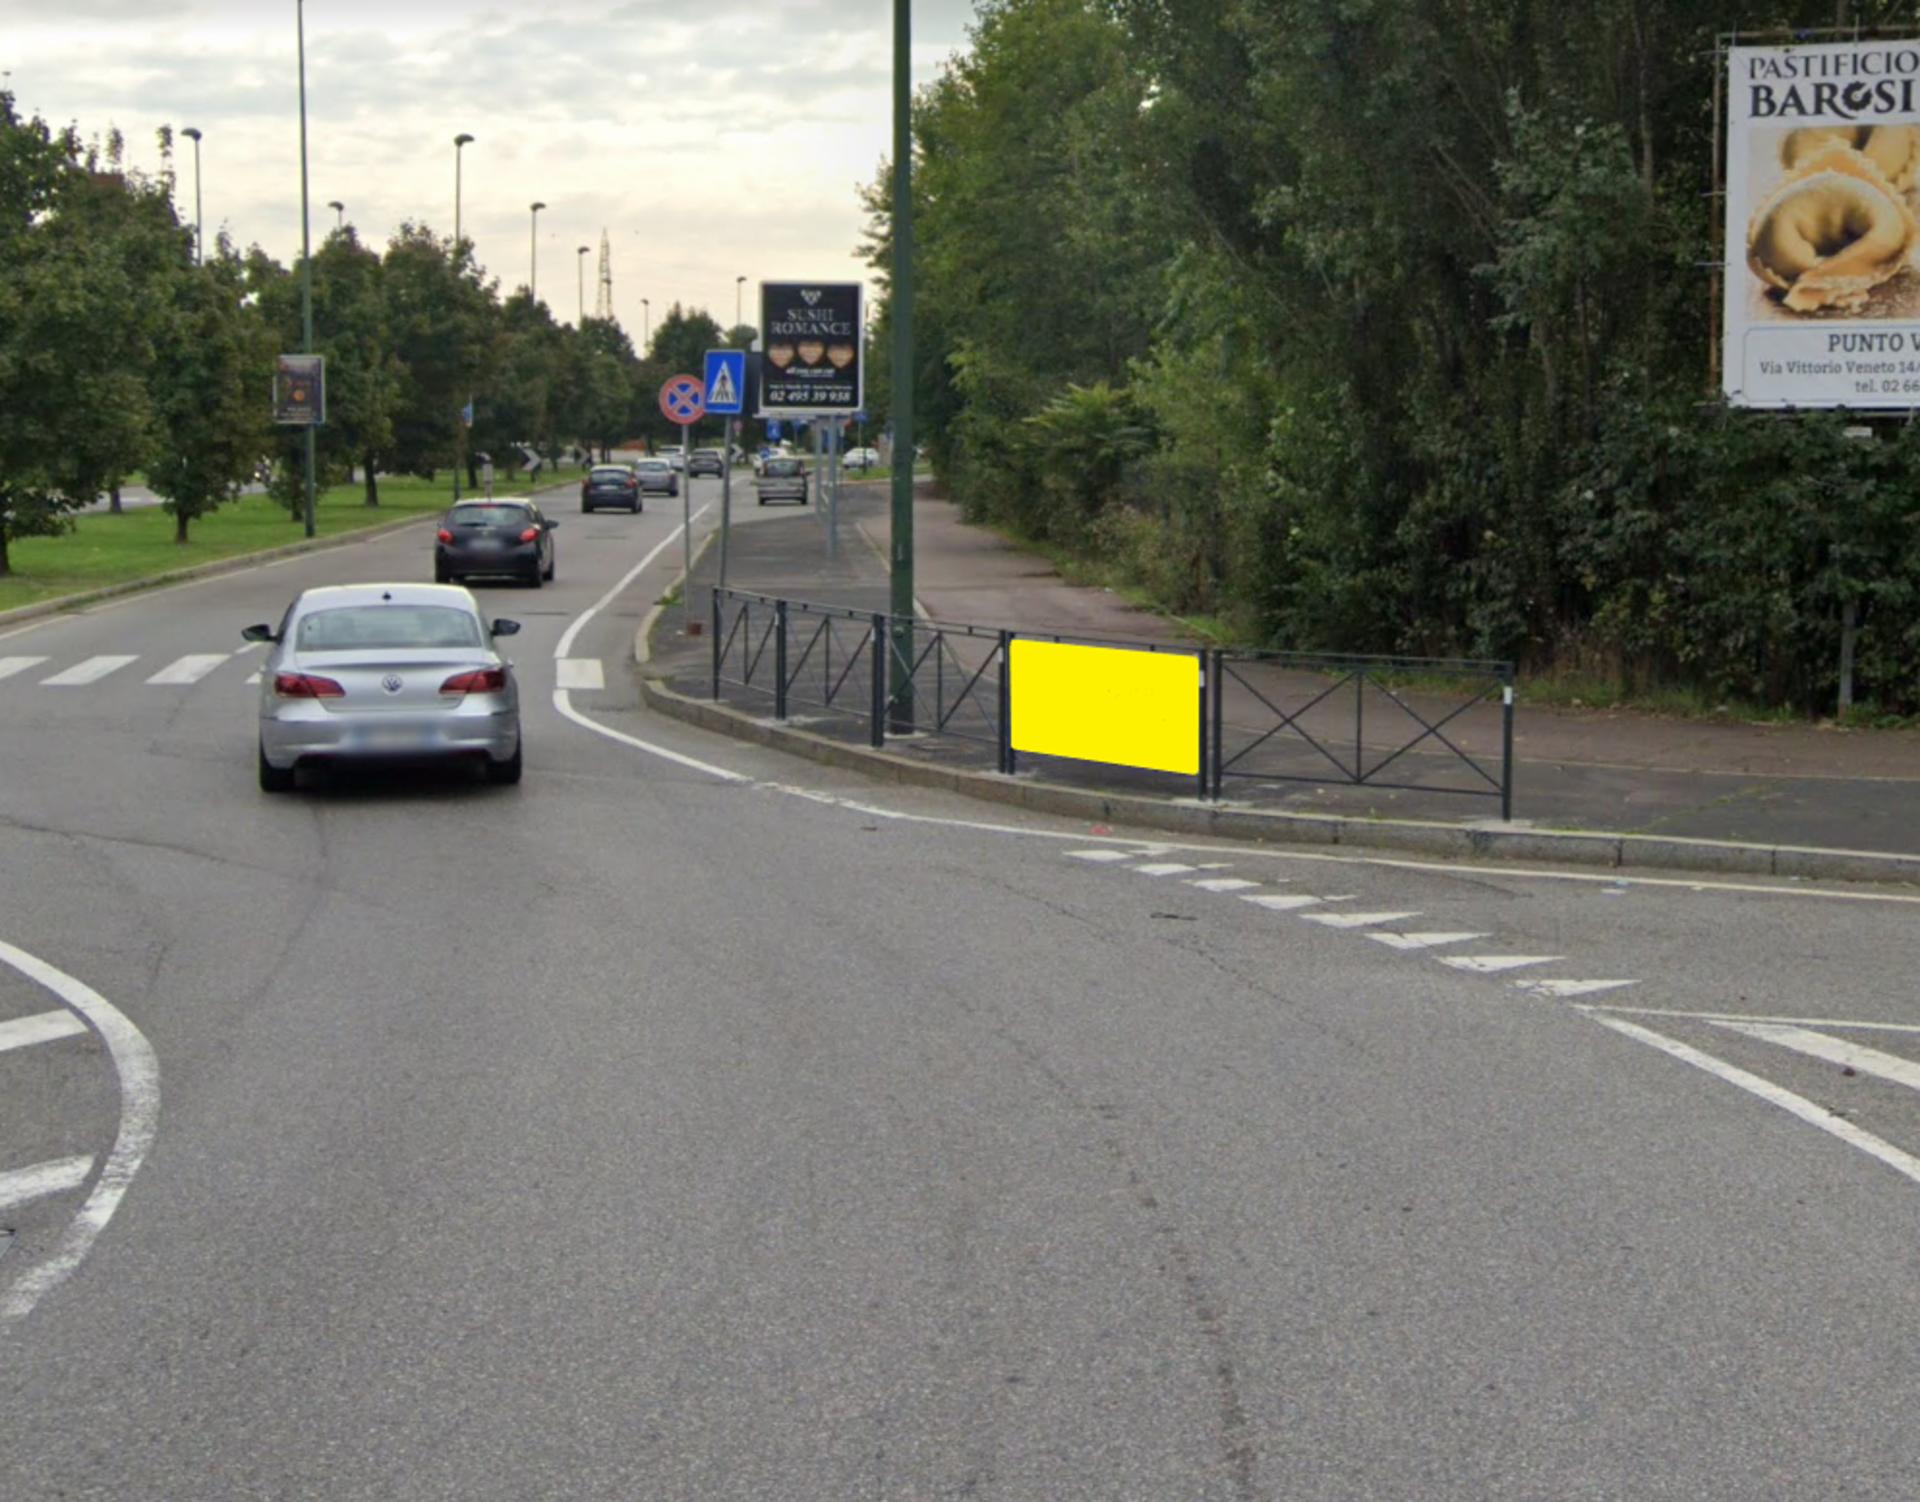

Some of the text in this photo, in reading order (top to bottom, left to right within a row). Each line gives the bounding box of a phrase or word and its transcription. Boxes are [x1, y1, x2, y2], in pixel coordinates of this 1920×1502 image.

[1750, 50, 1919, 79] PASTIFICIO
[1749, 79, 1916, 119] BAROSI
[787, 308, 834, 321] SUSHI
[772, 321, 851, 335] ROMANCE
[1828, 333, 1904, 352] PUNTO
[1760, 361, 1782, 374] Via
[1786, 360, 1842, 374] Vittorio
[1846, 361, 1895, 374] Veneto
[1854, 380, 1877, 393] tel.
[1881, 380, 1900, 393] 02
[769, 391, 785, 402] 02
